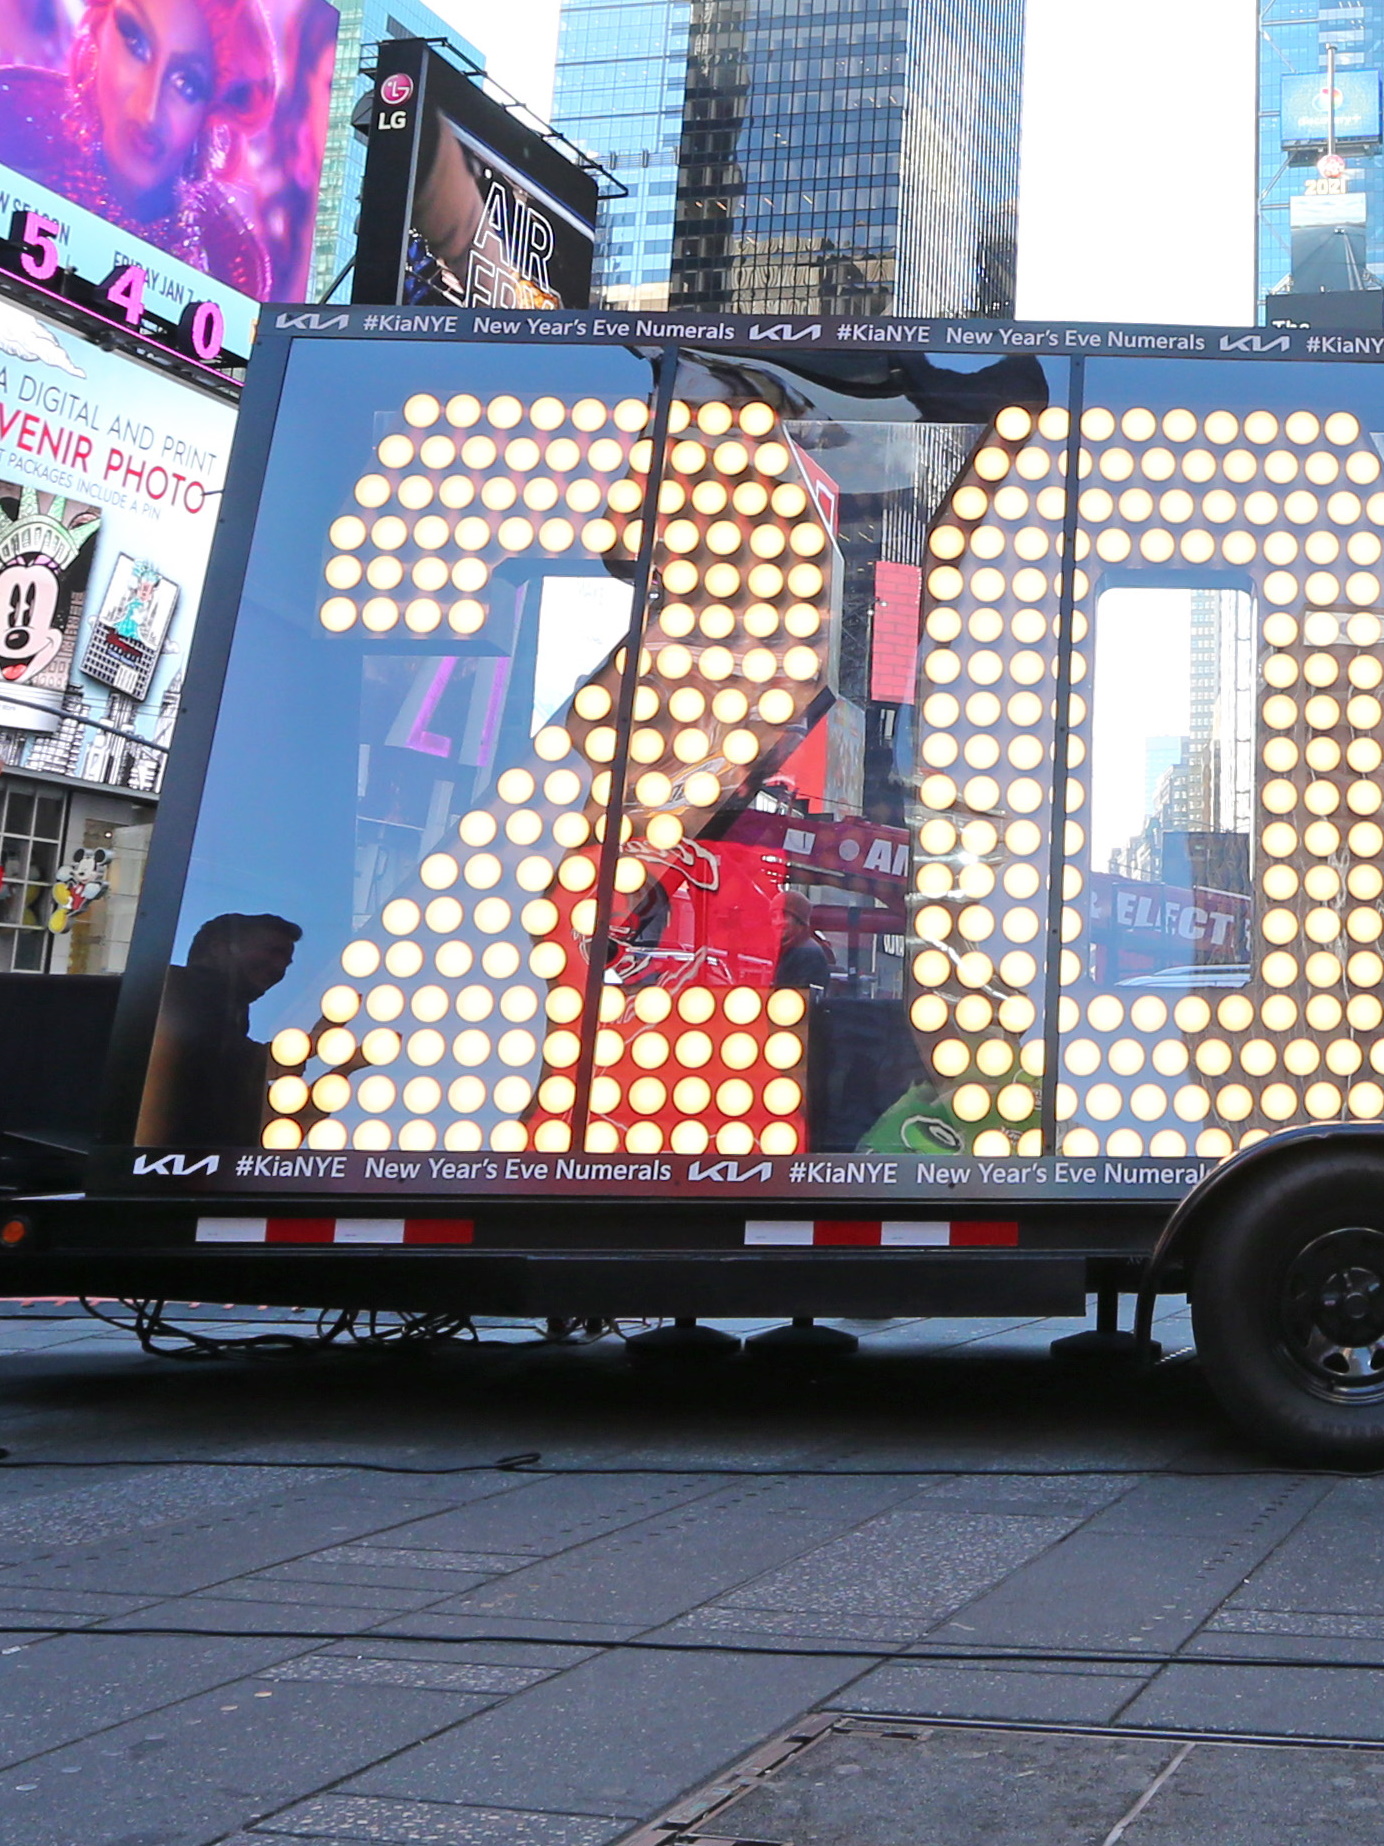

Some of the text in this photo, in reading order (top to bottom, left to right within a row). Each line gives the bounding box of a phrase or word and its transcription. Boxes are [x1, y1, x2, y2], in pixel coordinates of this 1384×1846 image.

[378, 110, 407, 130] LG
[474, 181, 554, 294] AIR
[159, 275, 185, 305] JAN
[364, 315, 457, 333] #KiaNYE
[474, 318, 521, 334] New
[528, 319, 586, 336] Year's
[593, 320, 629, 336] Eve
[637, 321, 735, 340] Numerals
[837, 324, 930, 343] #KiaNYE
[947, 328, 993, 345] New
[999, 329, 1058, 346] Year's
[1066, 330, 1101, 347] Eve
[1108, 331, 1205, 350] Numerals
[18, 374, 100, 431] DIGITAL
[107, 415, 155, 450] AND
[161, 436, 217, 476] PRINT
[7, 452, 73, 489] PACKAGES
[76, 478, 127, 508] INCLUDE
[142, 503, 162, 520] PIN
[103, 447, 205, 514] PHOTO
[236, 1155, 347, 1178] #KiaNYE
[365, 1158, 421, 1179] New
[429, 1158, 497, 1179] Year's
[505, 1159, 548, 1180] Eve
[556, 1159, 671, 1181] Numerals
[790, 1162, 897, 1184] #KiaNYE
[917, 1163, 972, 1184] New
[978, 1163, 1047, 1184] Year's
[1055, 1163, 1097, 1184] Eve
